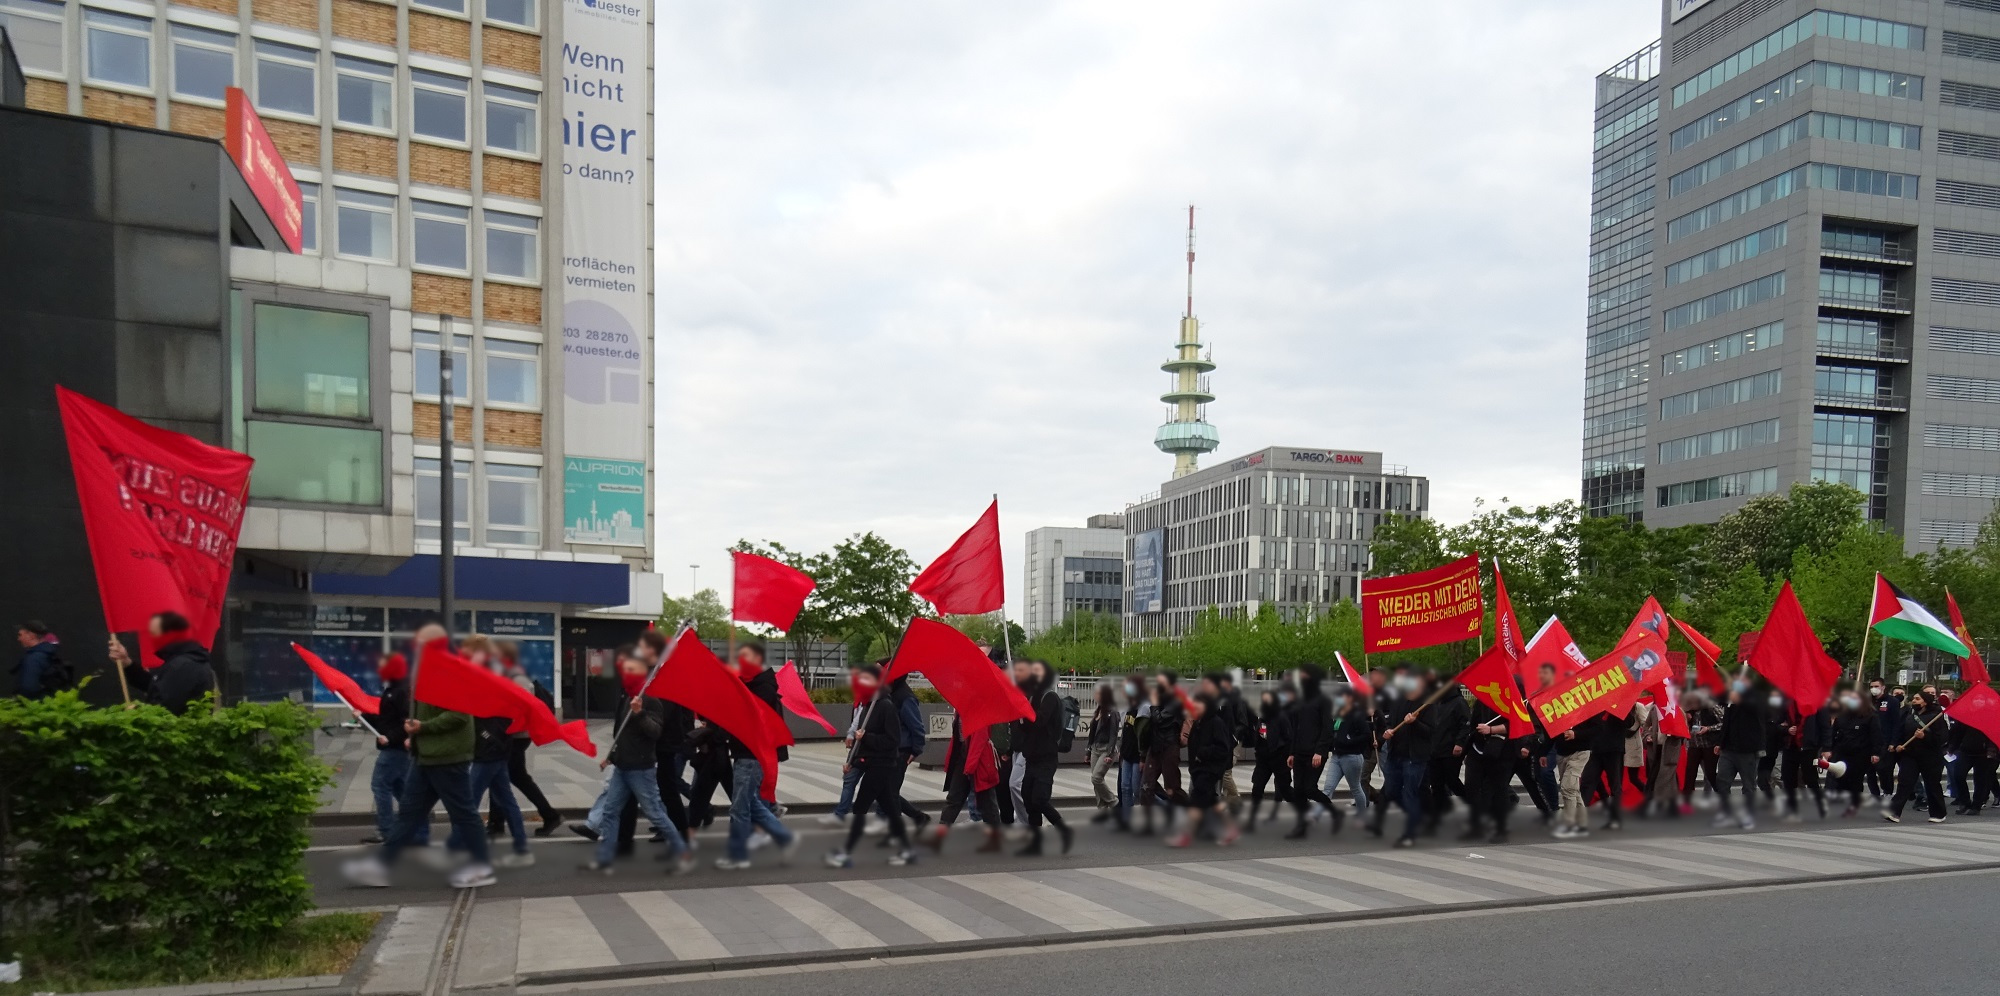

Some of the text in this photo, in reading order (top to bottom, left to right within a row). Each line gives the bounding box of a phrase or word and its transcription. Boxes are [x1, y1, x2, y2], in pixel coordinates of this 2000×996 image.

[562, 43, 624, 74] Wenn
[578, 163, 634, 185] dann?
[562, 256, 635, 275] roflächen
[566, 275, 636, 293] vermieten
[566, 460, 644, 477] AUPRION
[1378, 575, 1478, 616] NIEDER MIT DEM
[1381, 604, 1457, 628] IMPERIALISTISCHEN
[1458, 597, 1478, 616] KRIEG
